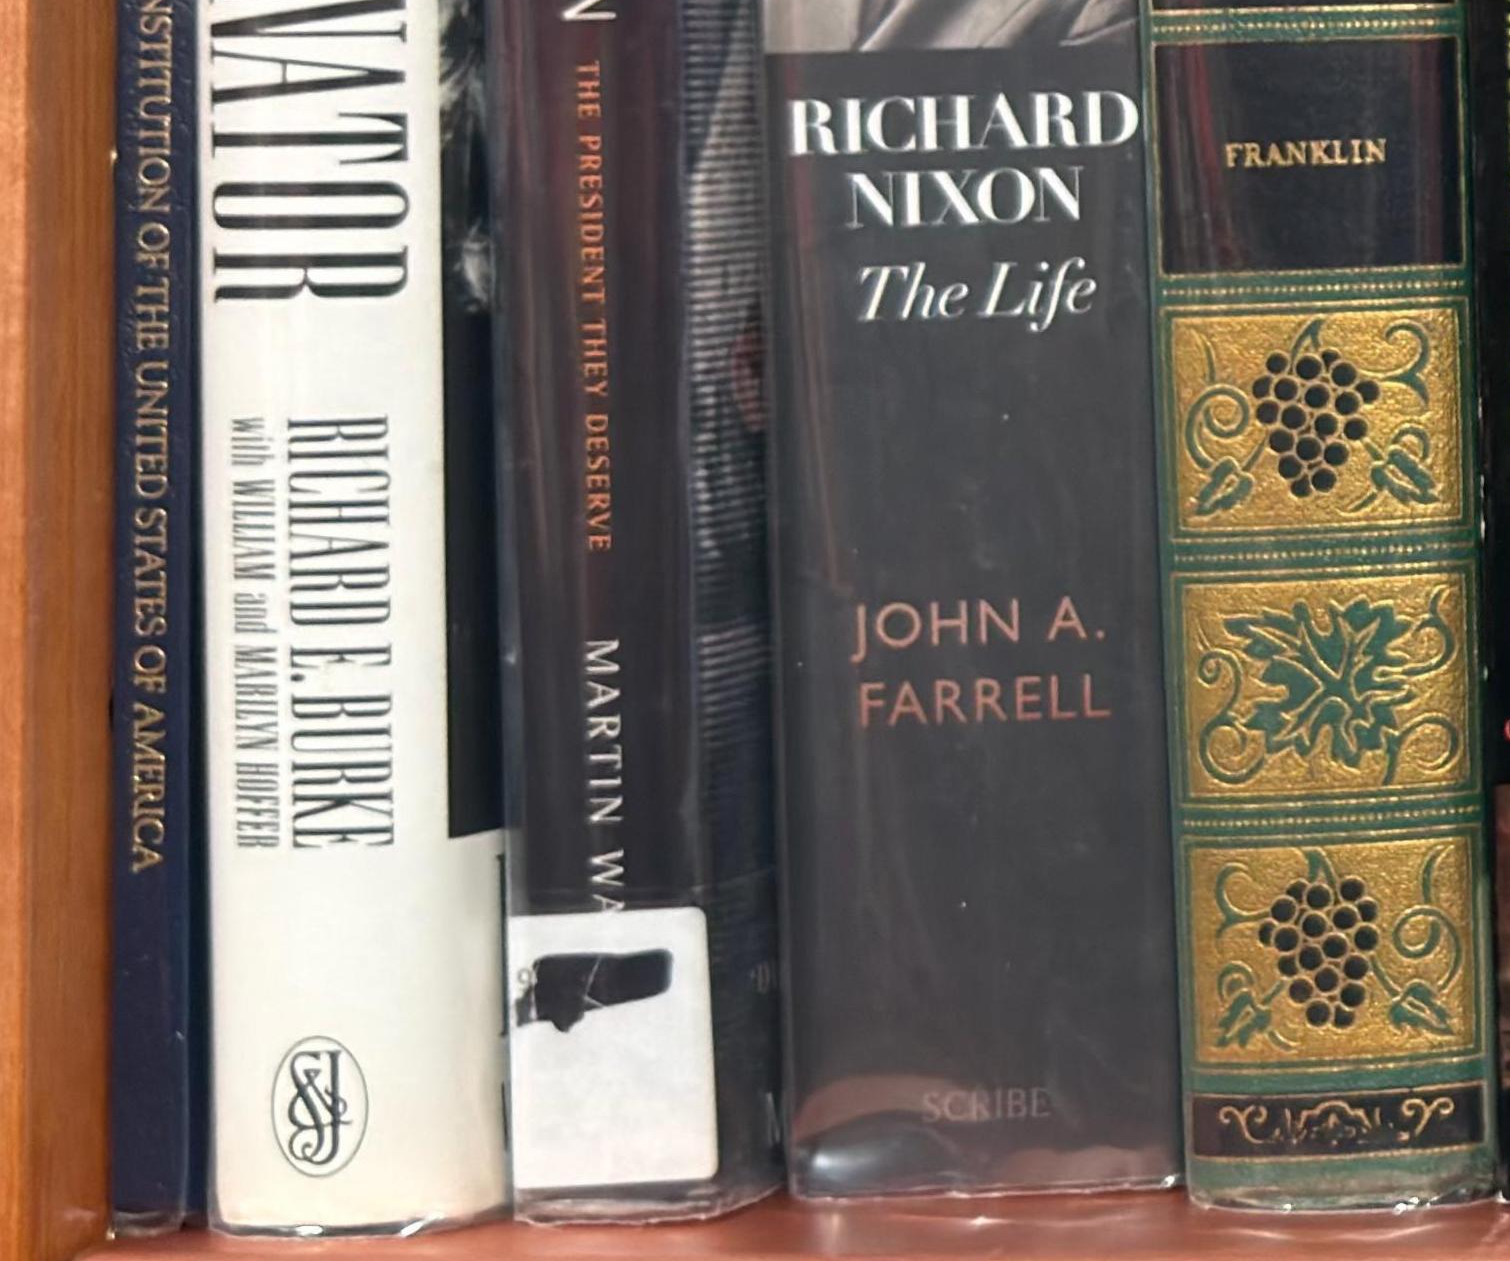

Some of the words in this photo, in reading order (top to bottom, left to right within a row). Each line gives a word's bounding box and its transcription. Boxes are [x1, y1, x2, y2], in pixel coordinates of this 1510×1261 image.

[788, 90, 1139, 156] RICHARD
[1224, 138, 1388, 169] FRANKLIN
[845, 166, 1084, 229] NIXON
[137, 224, 170, 268] OF
[136, 279, 170, 350] THE
[856, 263, 969, 322] The
[978, 257, 1098, 333] Life
[134, 360, 169, 499] UNITED
[231, 416, 275, 467] with
[232, 479, 277, 581] WILLIAM
[288, 416, 391, 626] RICHARD
[134, 510, 168, 637] STATES
[233, 592, 278, 634] and
[851, 597, 1021, 665] JOHN
[1047, 595, 1107, 640] A.
[133, 645, 167, 692] OF
[289, 642, 392, 683] E.
[234, 645, 279, 753] MARILYN
[582, 639, 624, 824] MARTIN
[859, 673, 1112, 728] FARRELL
[131, 703, 166, 873] AMERICA
[235, 761, 280, 849] HOFFER
[291, 694, 395, 849] BURKE
